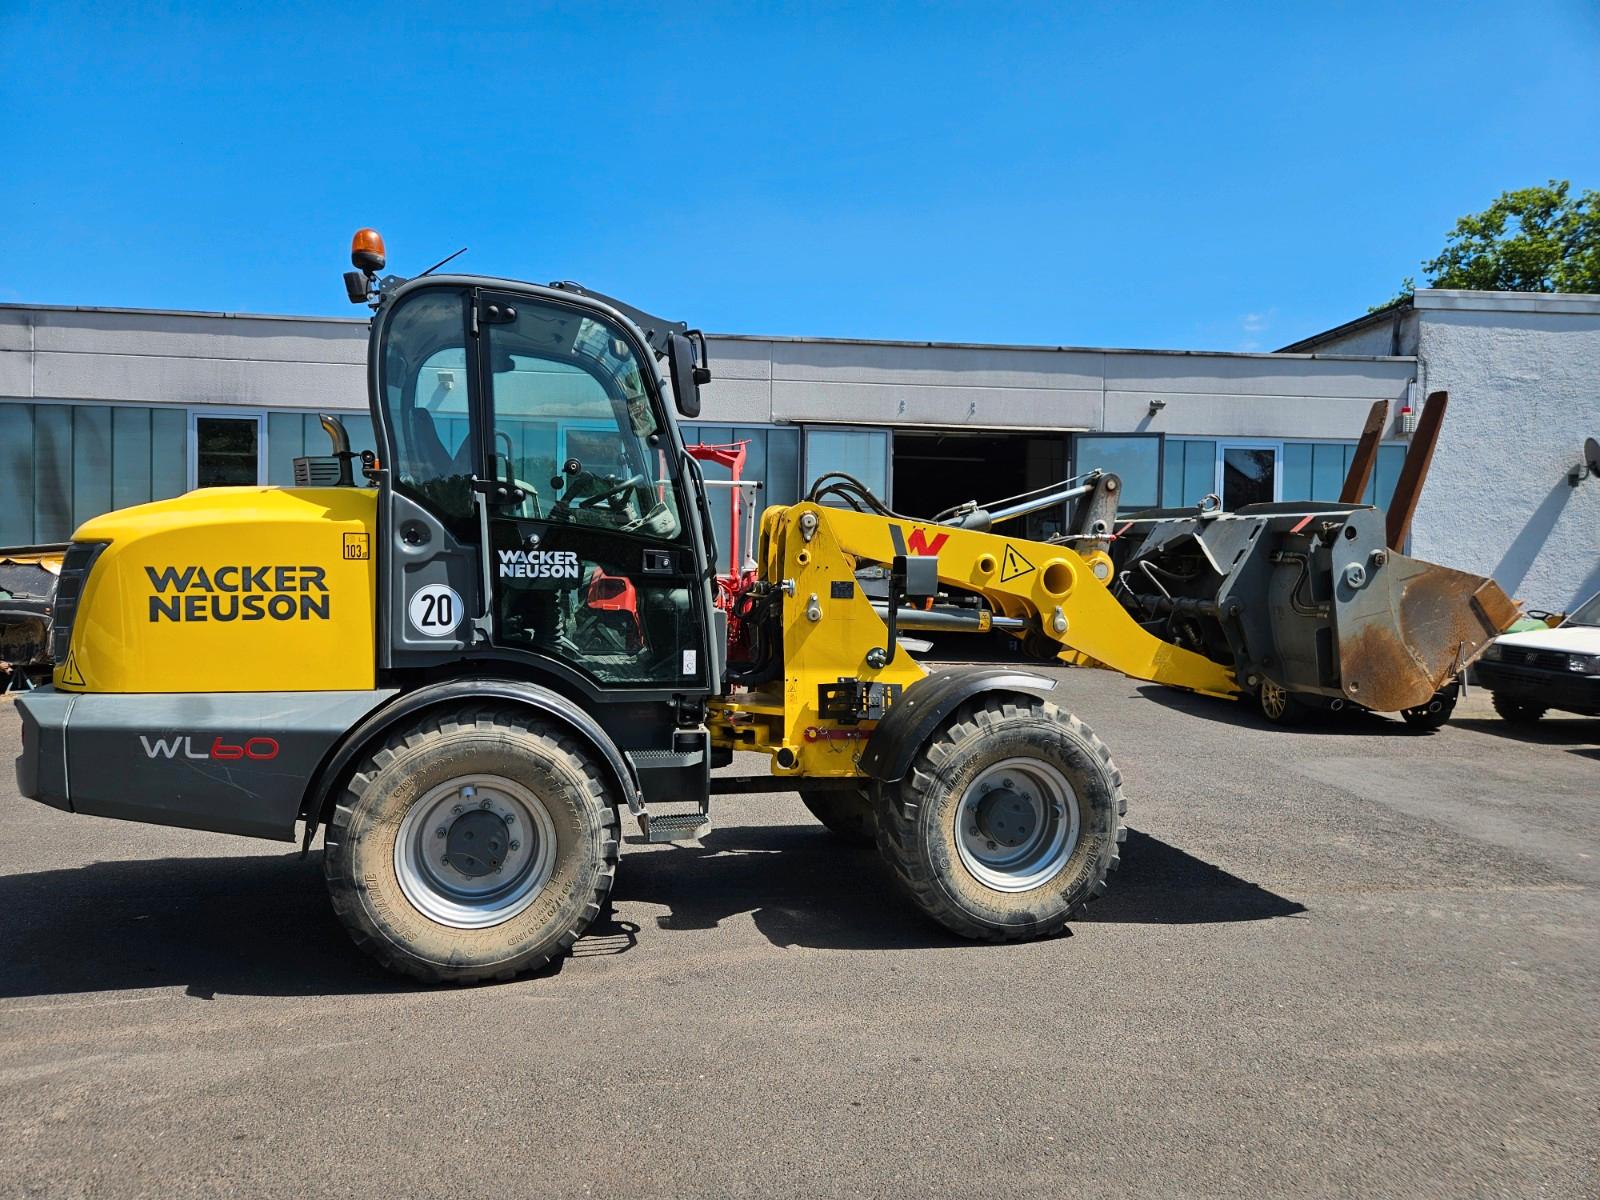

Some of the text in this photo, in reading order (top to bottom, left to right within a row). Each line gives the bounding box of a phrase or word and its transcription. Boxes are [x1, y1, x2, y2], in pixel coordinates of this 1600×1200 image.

[346, 544, 361, 558] 103
[498, 549, 578, 564] WACKER
[144, 566, 329, 593] WACKER
[499, 563, 578, 579] NEUSON
[149, 594, 330, 622] NEUSON
[421, 594, 452, 626] 20
[139, 735, 279, 760] WL60
